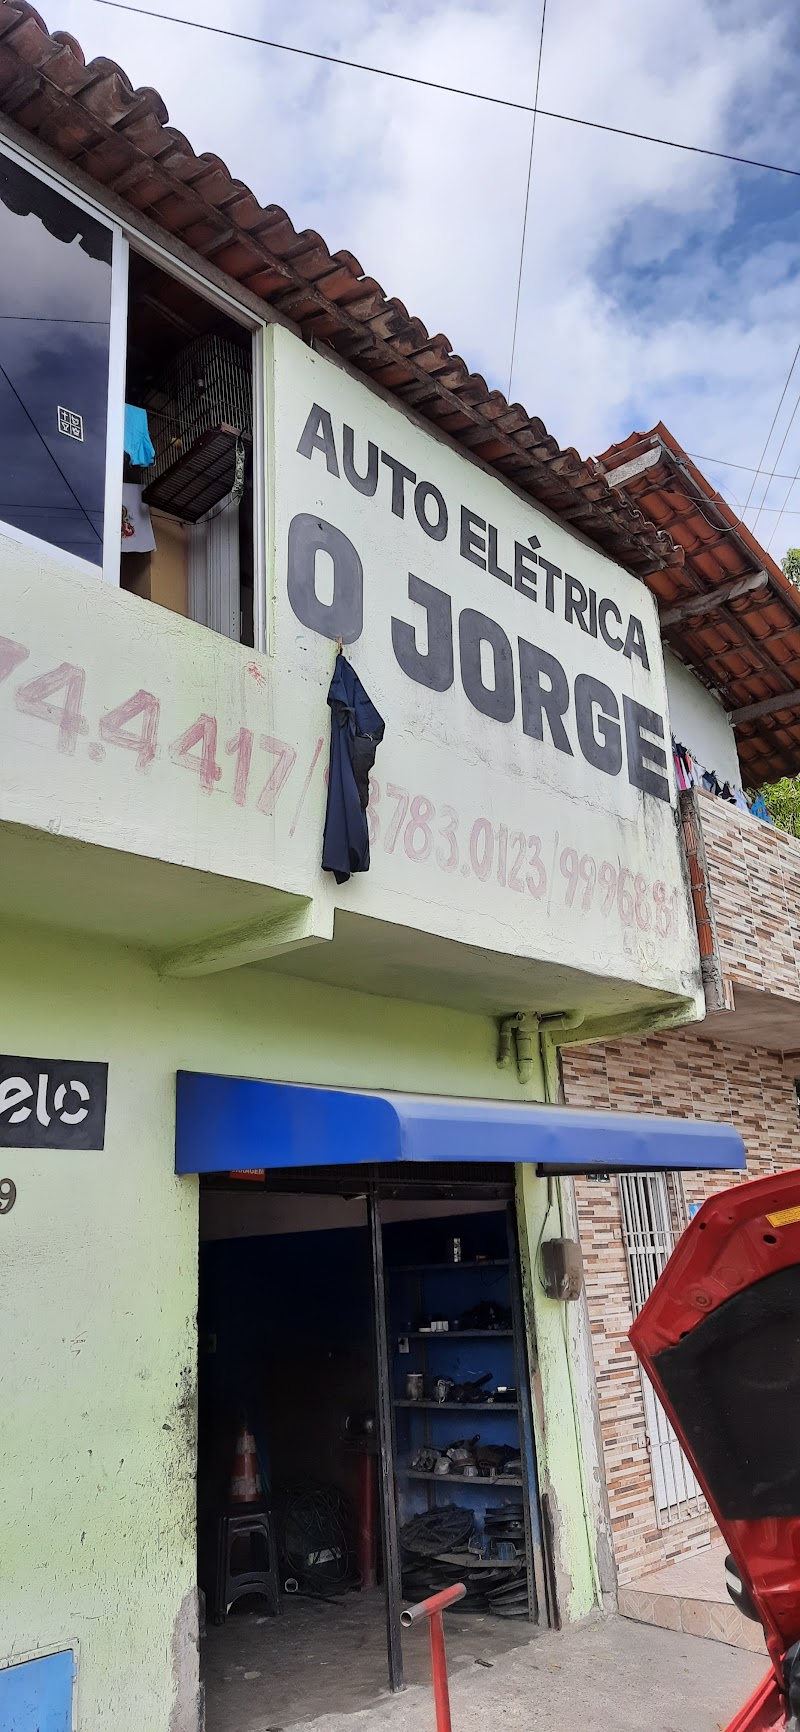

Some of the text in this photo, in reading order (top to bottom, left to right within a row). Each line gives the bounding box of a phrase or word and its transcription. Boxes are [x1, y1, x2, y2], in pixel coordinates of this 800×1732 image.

[286, 512, 672, 804] O JORGE
[296, 402, 651, 672] AUTO ELÉTRICA
